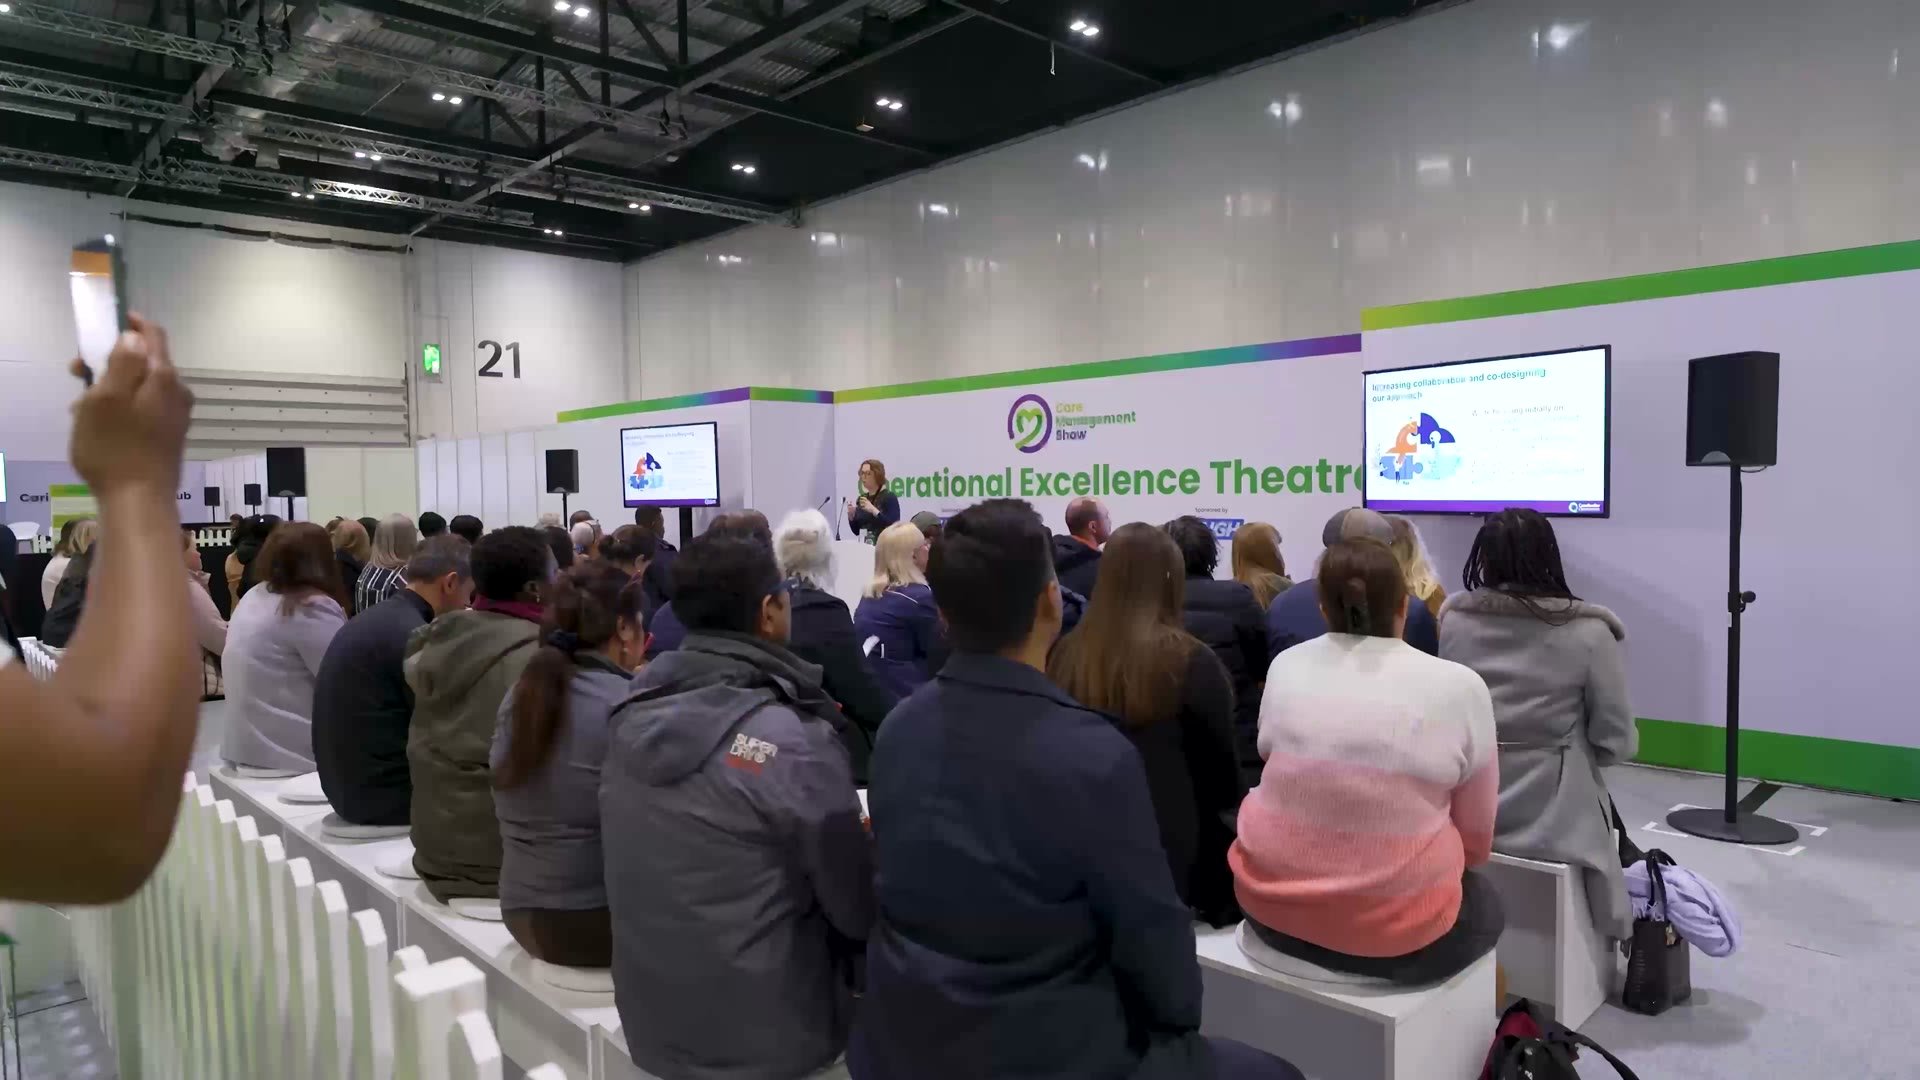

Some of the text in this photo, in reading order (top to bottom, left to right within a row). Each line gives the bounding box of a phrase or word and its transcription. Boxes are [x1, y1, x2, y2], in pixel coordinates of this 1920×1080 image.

[477, 340, 520, 378] 21
[1056, 402, 1083, 413] Care
[1055, 411, 1136, 428] Management
[1056, 429, 1087, 440] Show
[858, 466, 1012, 498] erational
[1020, 463, 1200, 496] Excellence
[19, 492, 49, 503] Cari
